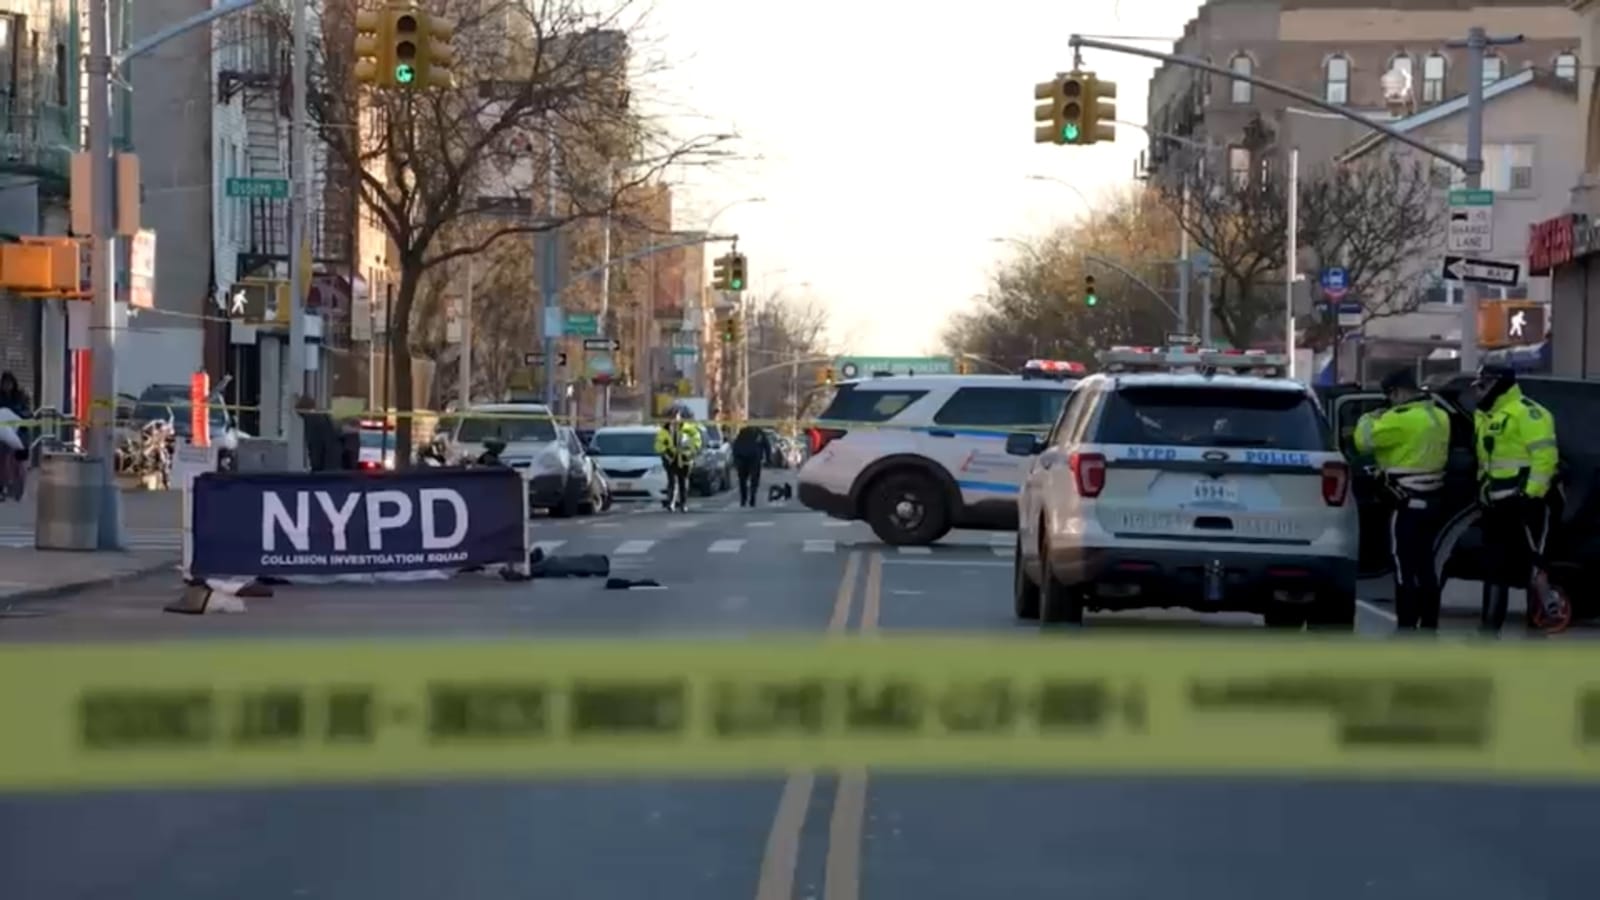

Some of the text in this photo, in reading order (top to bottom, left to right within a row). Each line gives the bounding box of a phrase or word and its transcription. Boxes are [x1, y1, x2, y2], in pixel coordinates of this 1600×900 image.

[1451, 224, 1489, 235] SHARED
[1456, 236, 1483, 248] LANE
[1486, 267, 1511, 279] WAY
[1127, 446, 1311, 464] NYPD POLICE
[262, 488, 469, 551] NYPD
[260, 551, 469, 566] COLLISION INVESTIGATION SQUAD
